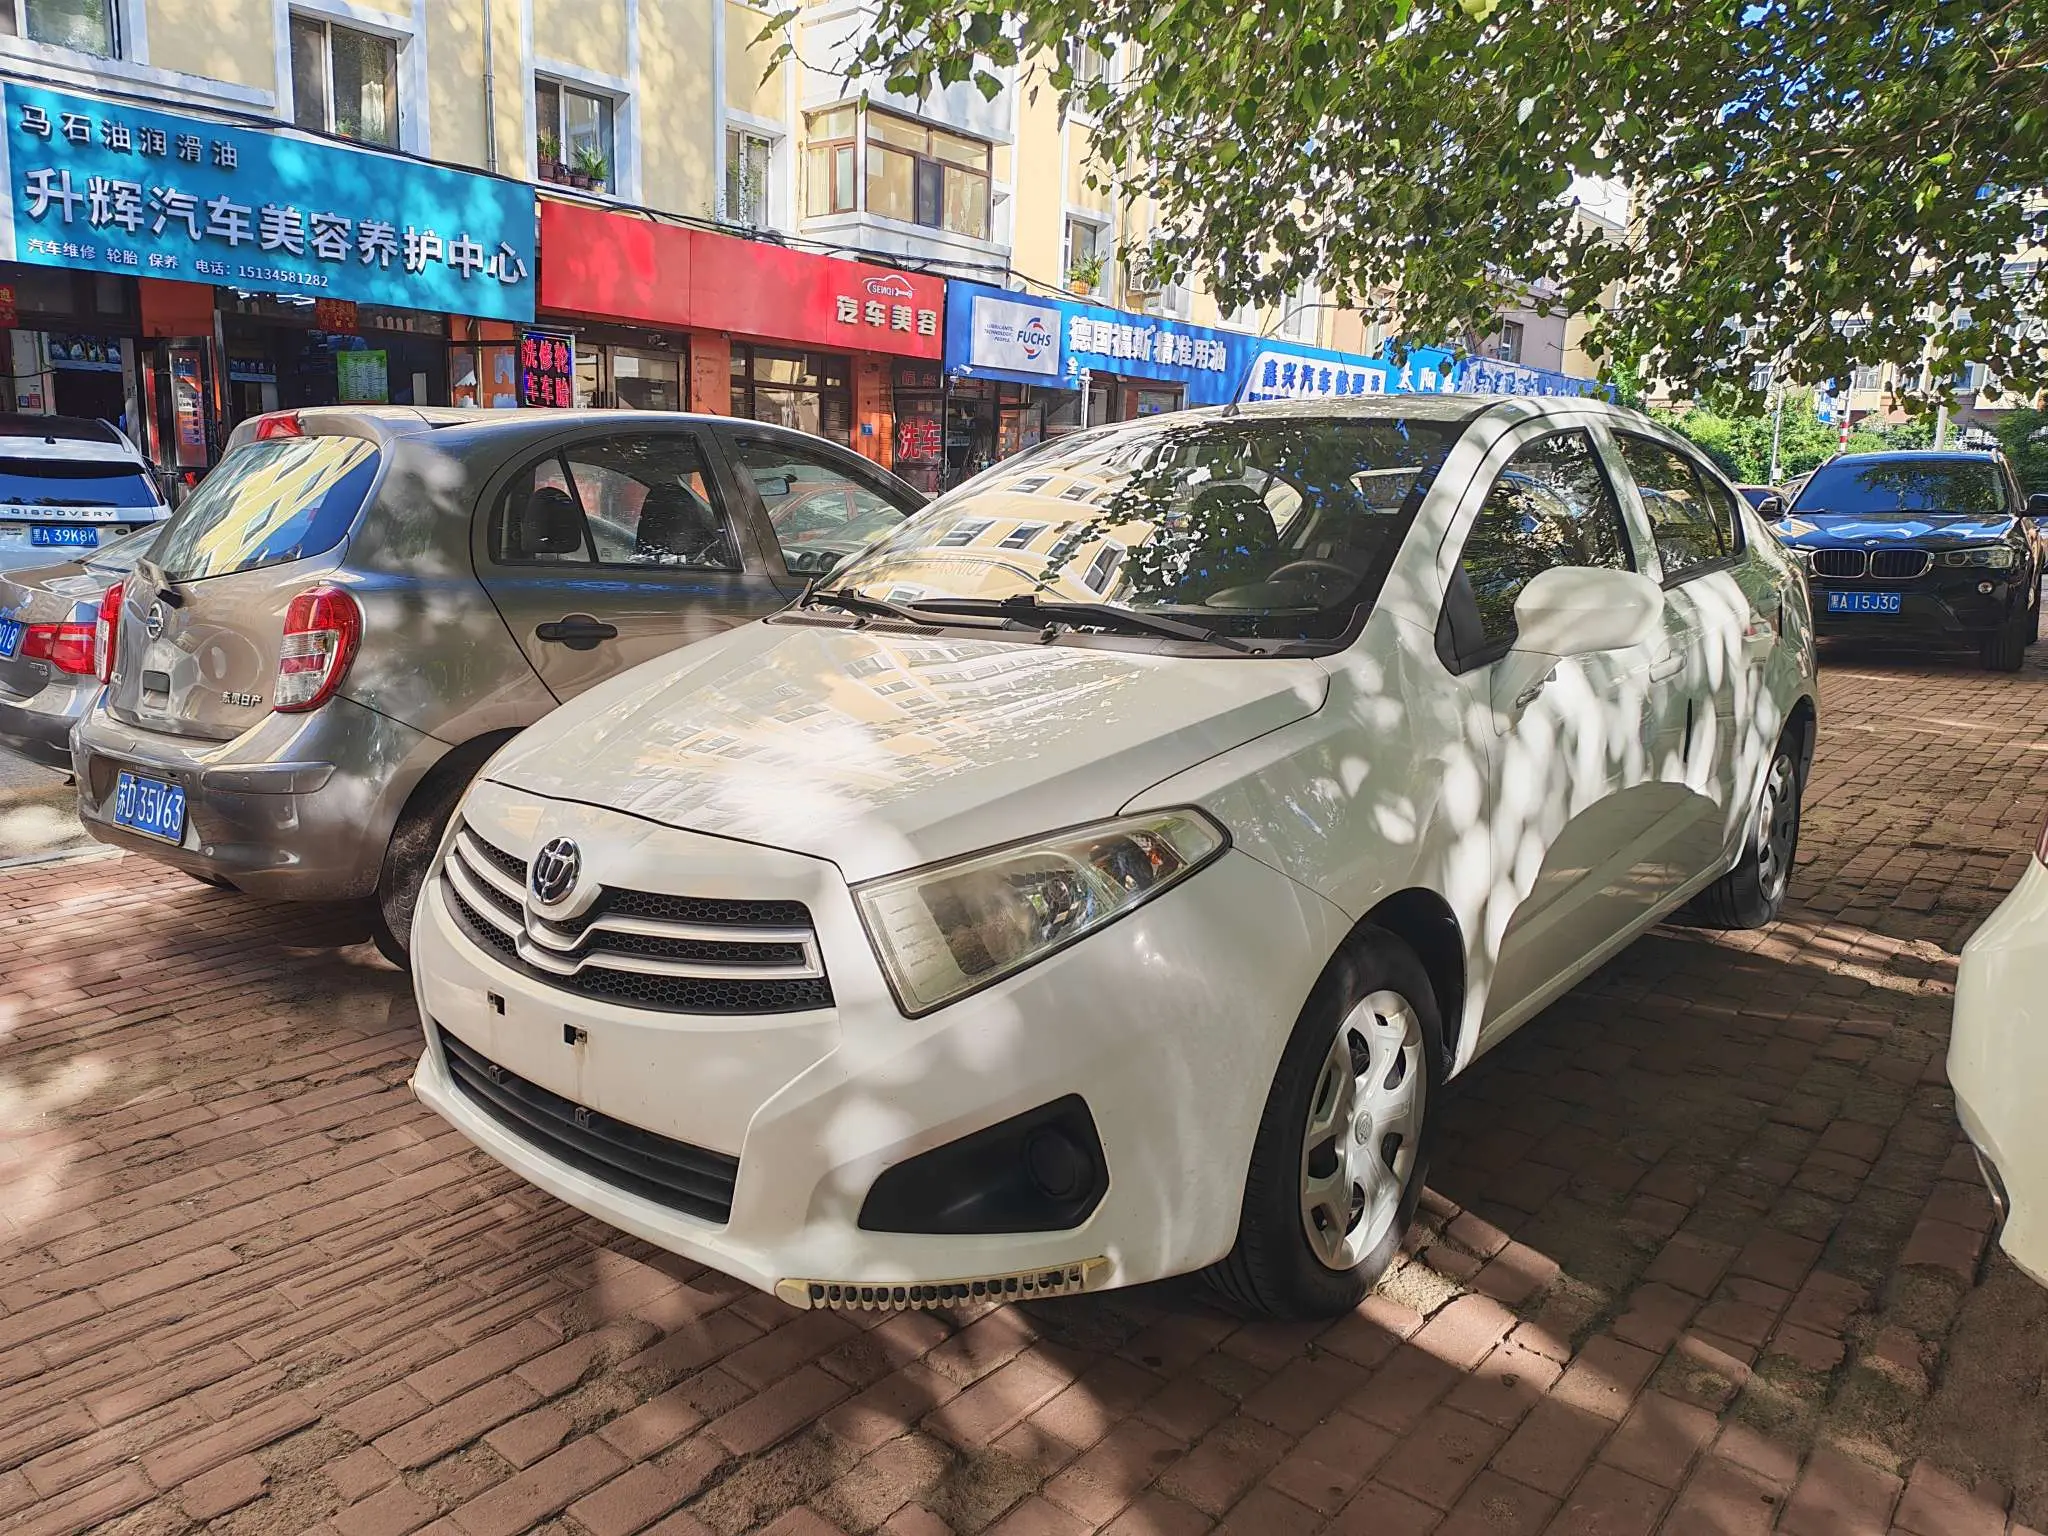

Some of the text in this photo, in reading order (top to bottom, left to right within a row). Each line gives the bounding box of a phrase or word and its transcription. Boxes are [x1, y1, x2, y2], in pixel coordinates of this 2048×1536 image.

[20, 104, 238, 169] 马石油润滑油
[26, 168, 528, 284] 升辉汽车美容养护中心
[27, 238, 96, 259] 汽车维修
[106, 247, 138, 265] 轮胎
[149, 253, 179, 269] 保养
[238, 264, 329, 288] 15134581282
[836, 294, 937, 337] 汽车美容
[1016, 330, 1052, 347] FUCHS
[898, 418, 943, 459] 洗车
[11, 507, 114, 518] DISCOVERY
[220, 690, 262, 708] 东风日产
